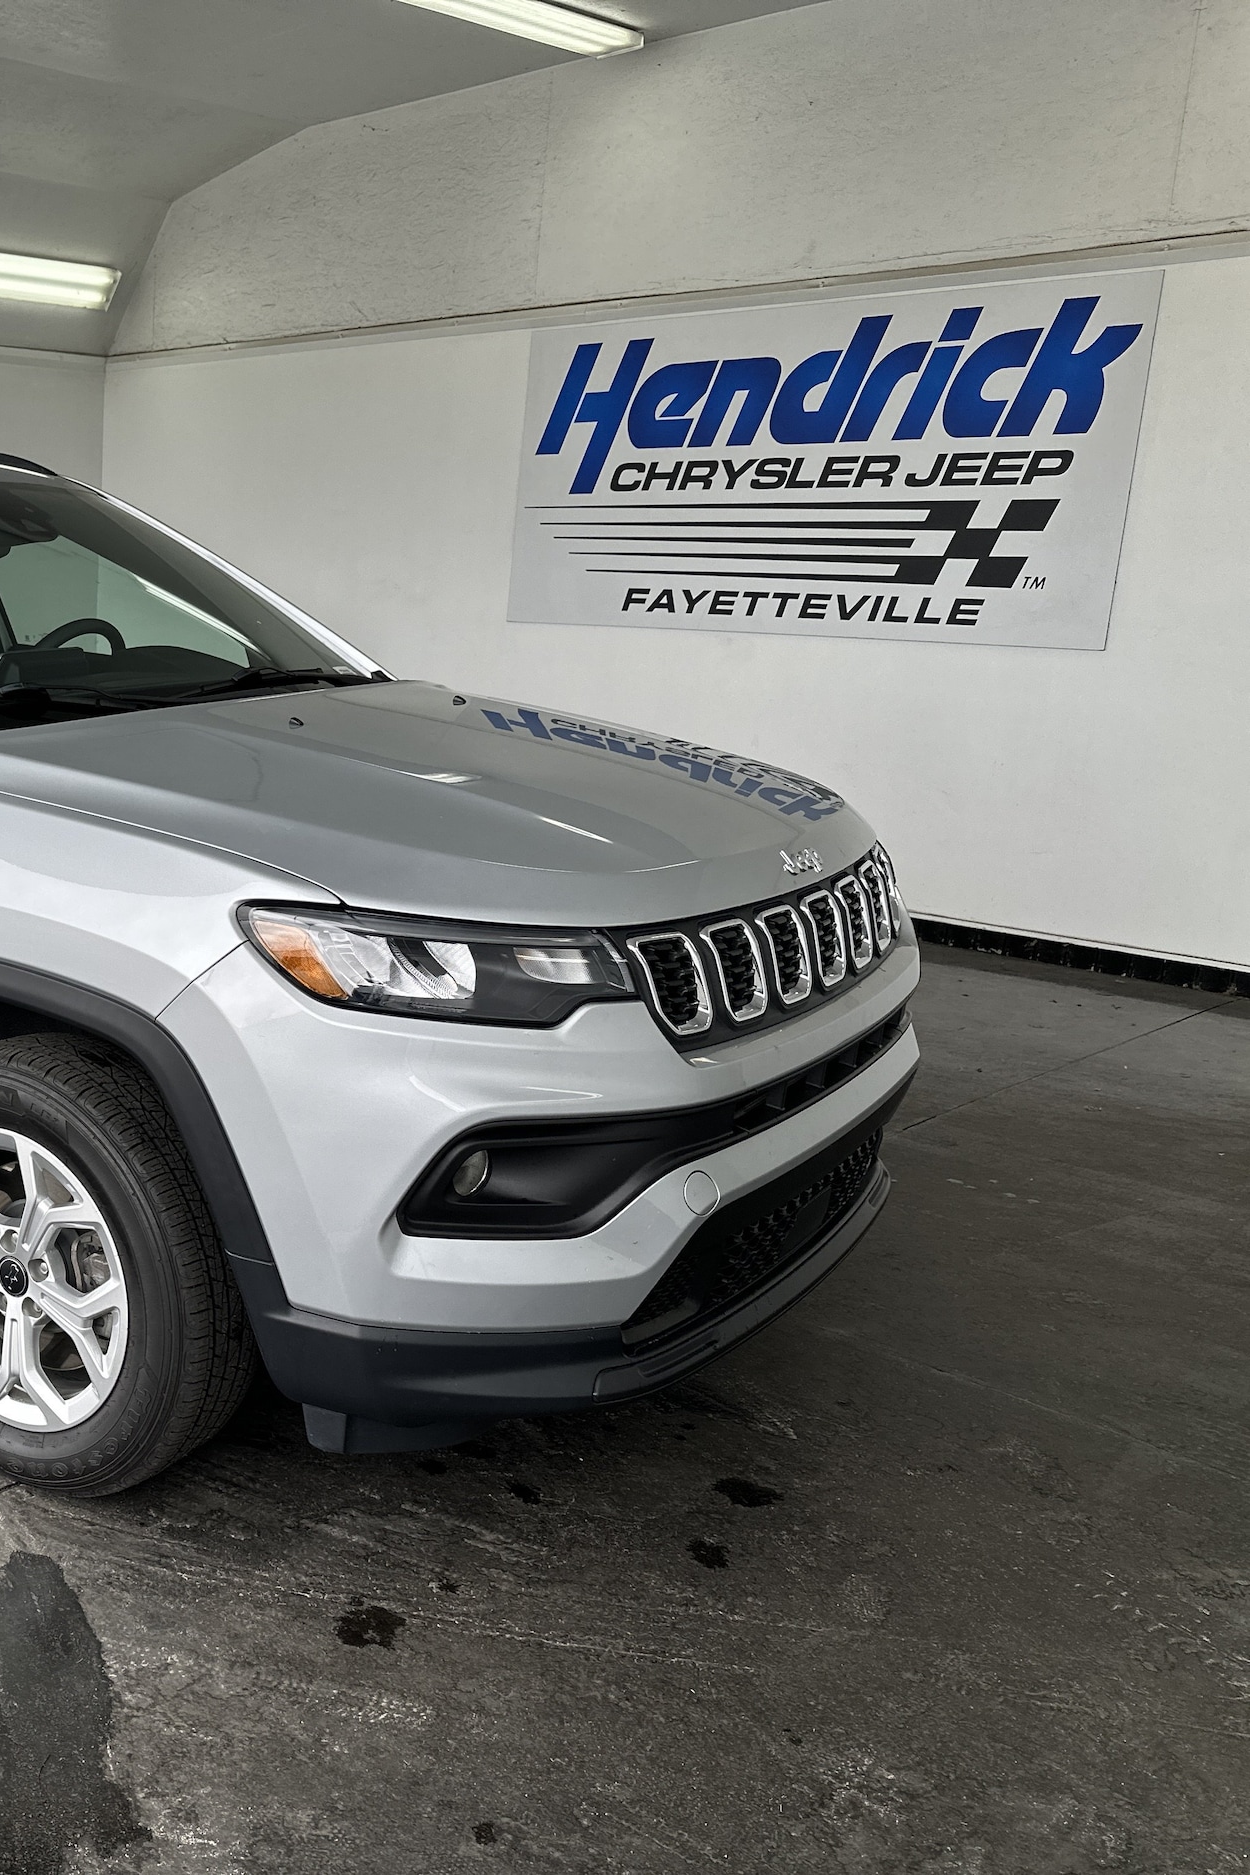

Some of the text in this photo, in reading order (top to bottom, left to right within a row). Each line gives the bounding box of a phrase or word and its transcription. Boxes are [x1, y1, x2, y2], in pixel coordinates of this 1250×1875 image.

[535, 295, 1144, 495] Hendrick
[609, 449, 1075, 493] CHRYSLER JEEP
[1022, 576, 1047, 590] TM
[621, 588, 986, 627] FAYETTEVILLE
[779, 849, 823, 875] Jeep
